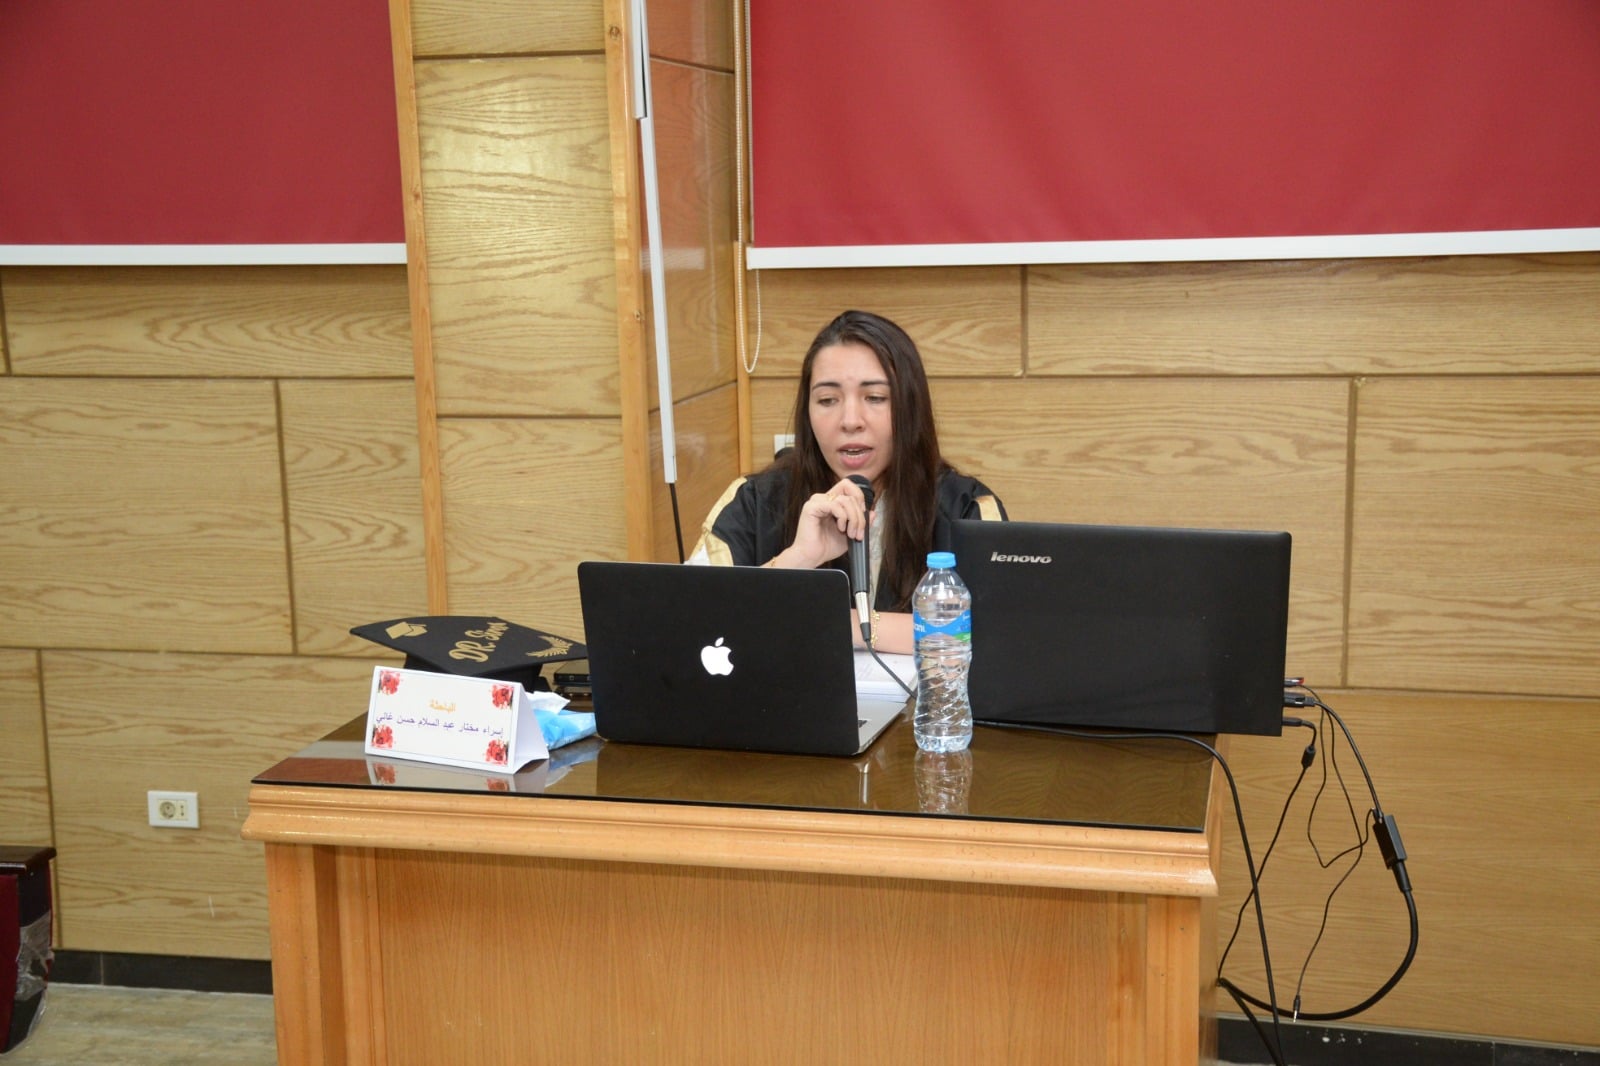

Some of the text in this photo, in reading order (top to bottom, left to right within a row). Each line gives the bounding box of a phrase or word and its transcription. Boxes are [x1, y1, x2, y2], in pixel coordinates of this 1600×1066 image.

[991, 551, 1052, 563] lenovo
[396, 715, 415, 724] حسن
[418, 716, 439, 727] السلام
[443, 720, 455, 730] عبد
[459, 722, 479, 732] مختار
